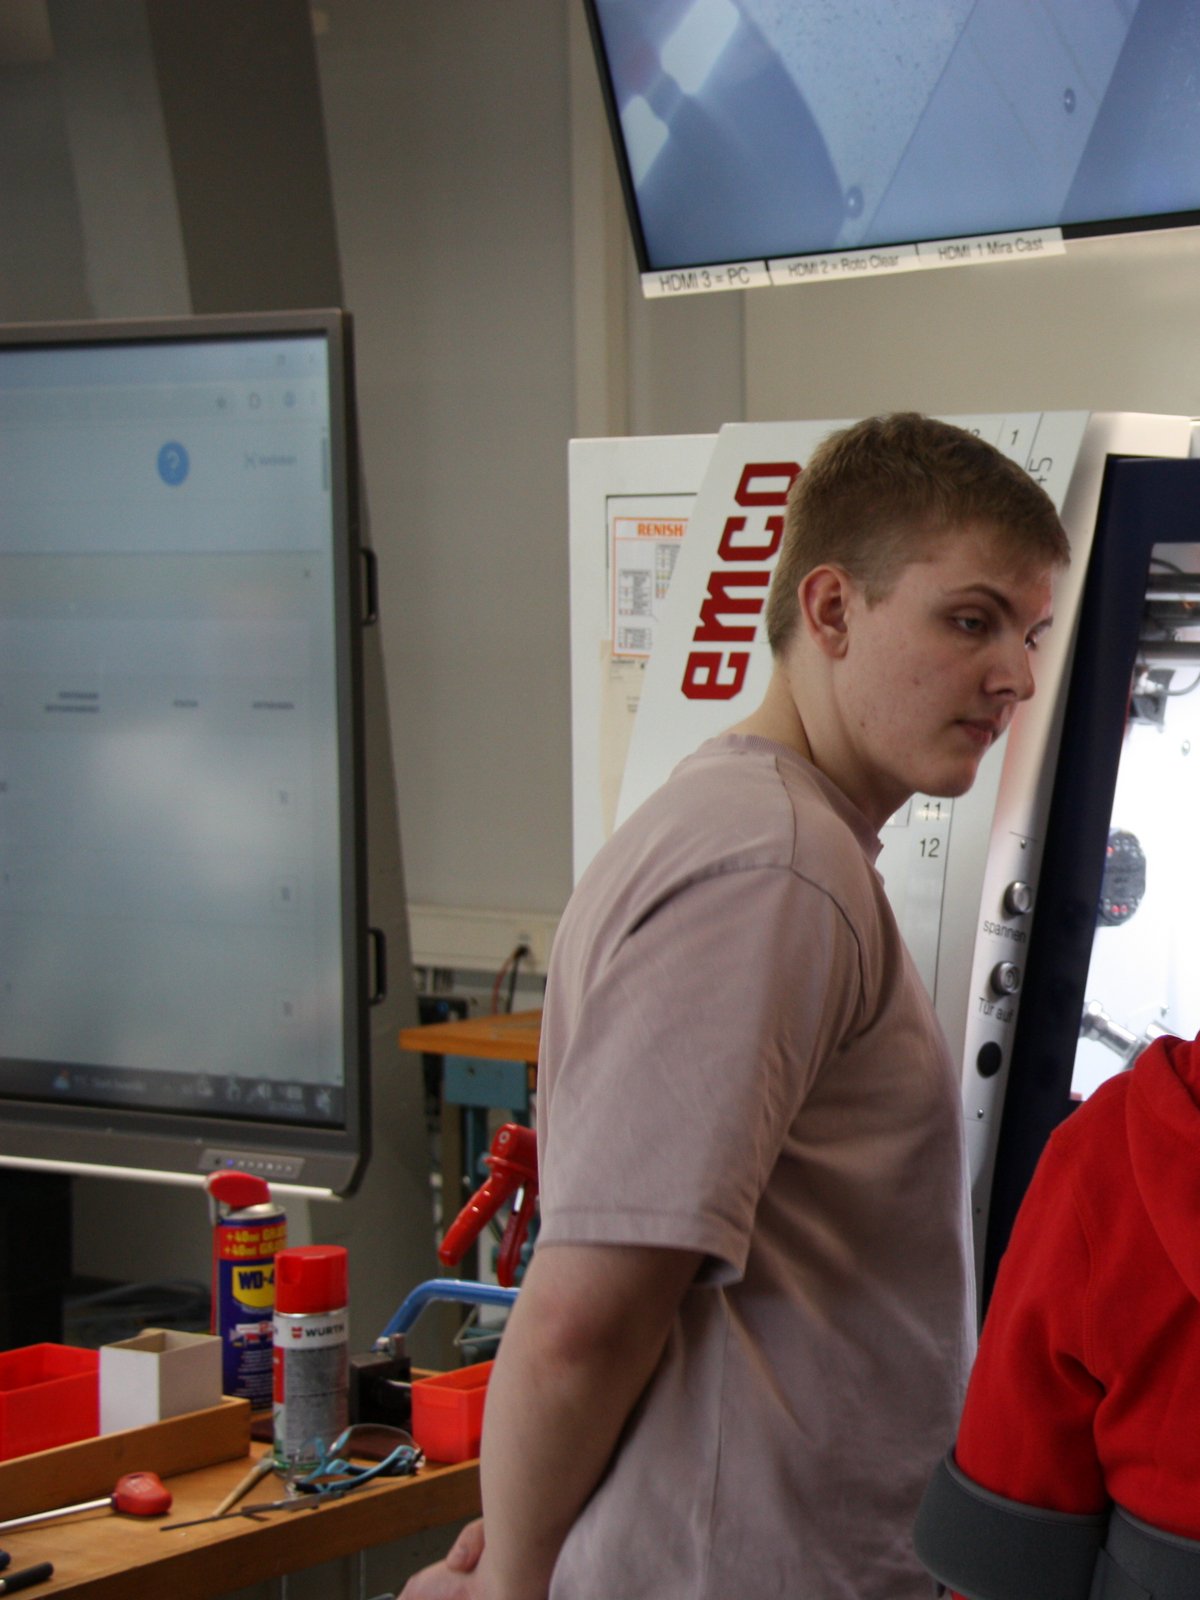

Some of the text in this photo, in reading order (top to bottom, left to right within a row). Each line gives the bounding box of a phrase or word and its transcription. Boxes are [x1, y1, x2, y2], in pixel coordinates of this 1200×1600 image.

[938, 245, 971, 261] HDMI
[986, 239, 1013, 255] Mira
[1016, 236, 1043, 252] Cast
[788, 262, 819, 277] HDMI
[821, 261, 828, 274] 2
[841, 257, 868, 272] Roto
[870, 254, 899, 268] Clear
[659, 272, 698, 292] HDMI
[701, 270, 713, 288] 3
[728, 267, 750, 285] PC
[636, 522, 686, 537] RENISH
[680, 461, 803, 700] emco
[923, 802, 941, 821] 11
[920, 837, 940, 858] 12
[983, 918, 1027, 945] spannen
[238, 1271, 275, 1290] WD-4
